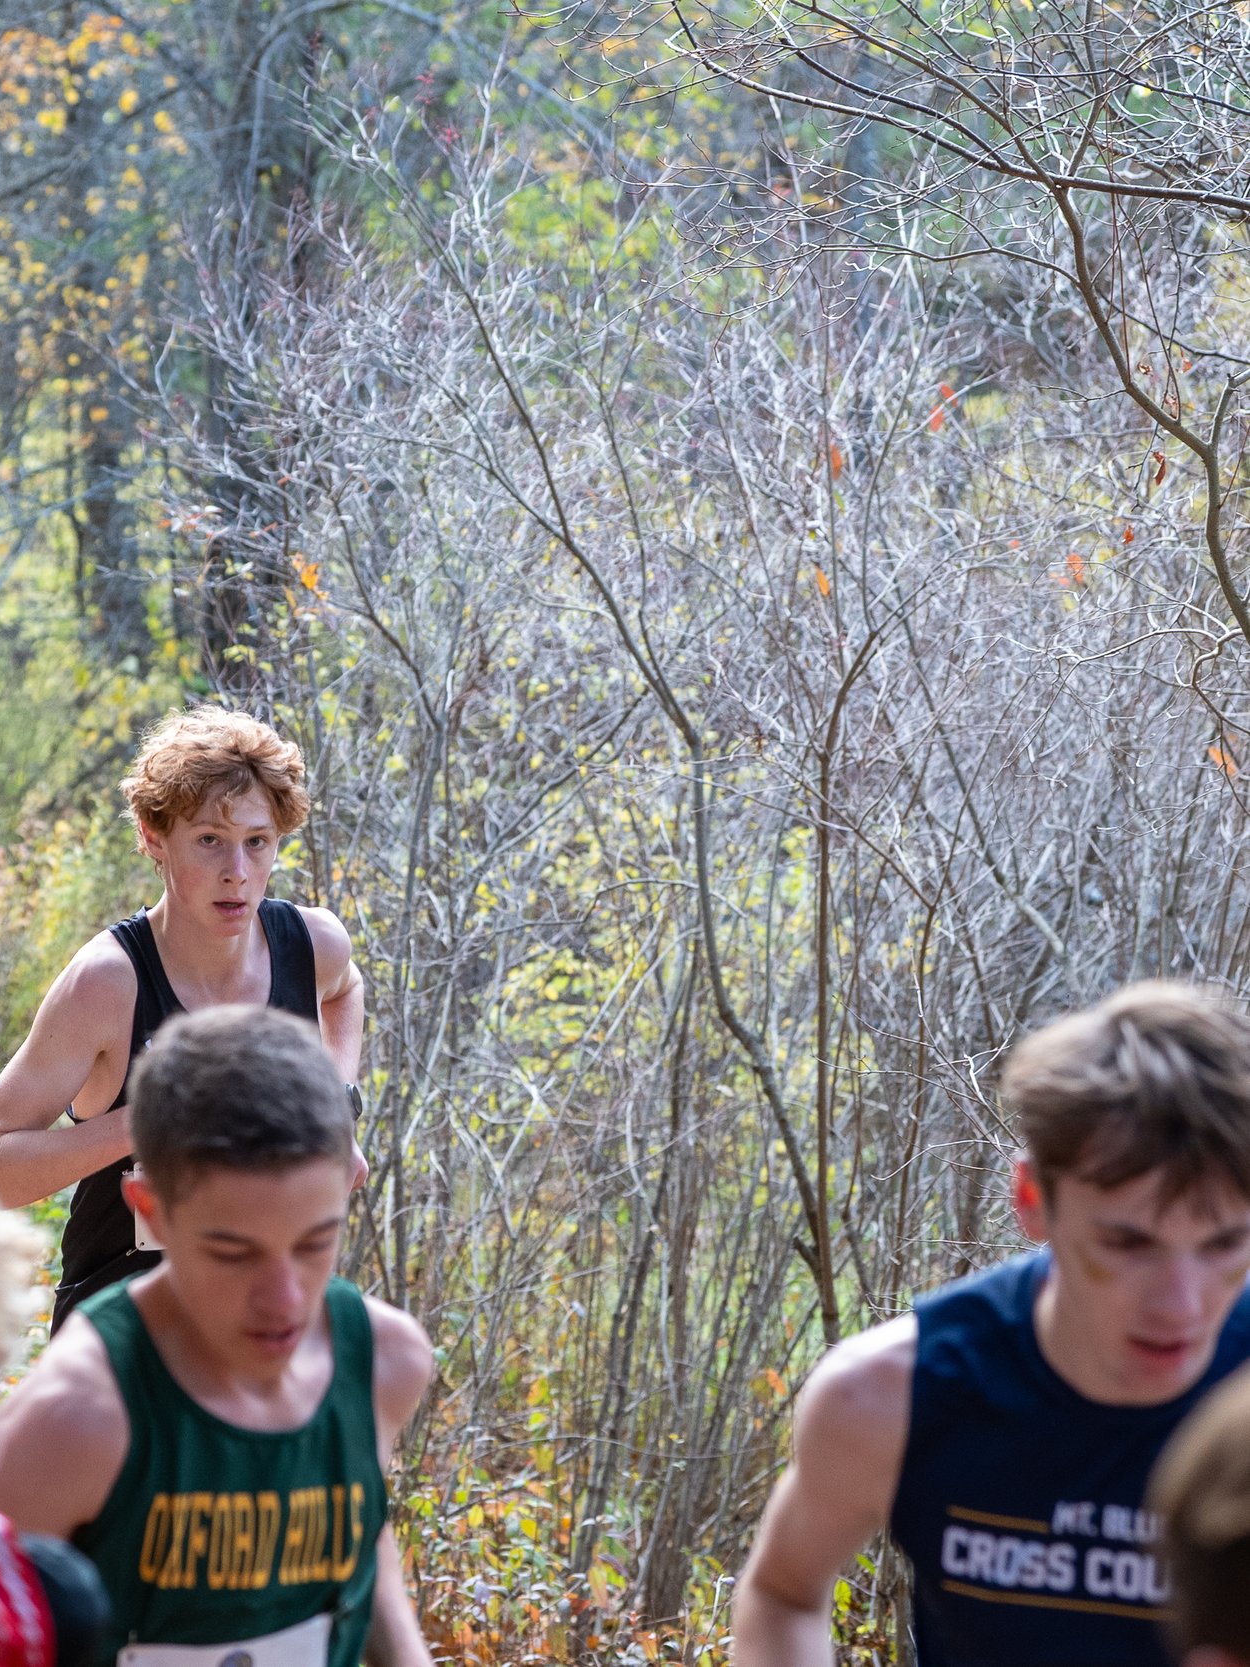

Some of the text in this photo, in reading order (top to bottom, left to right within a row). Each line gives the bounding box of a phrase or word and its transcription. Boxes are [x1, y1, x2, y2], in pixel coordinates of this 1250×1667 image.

[139, 1482, 365, 1590] OXFORD HILLS
[942, 1524, 1078, 1592] CROSS
[1101, 1503, 1166, 1546] BLU
